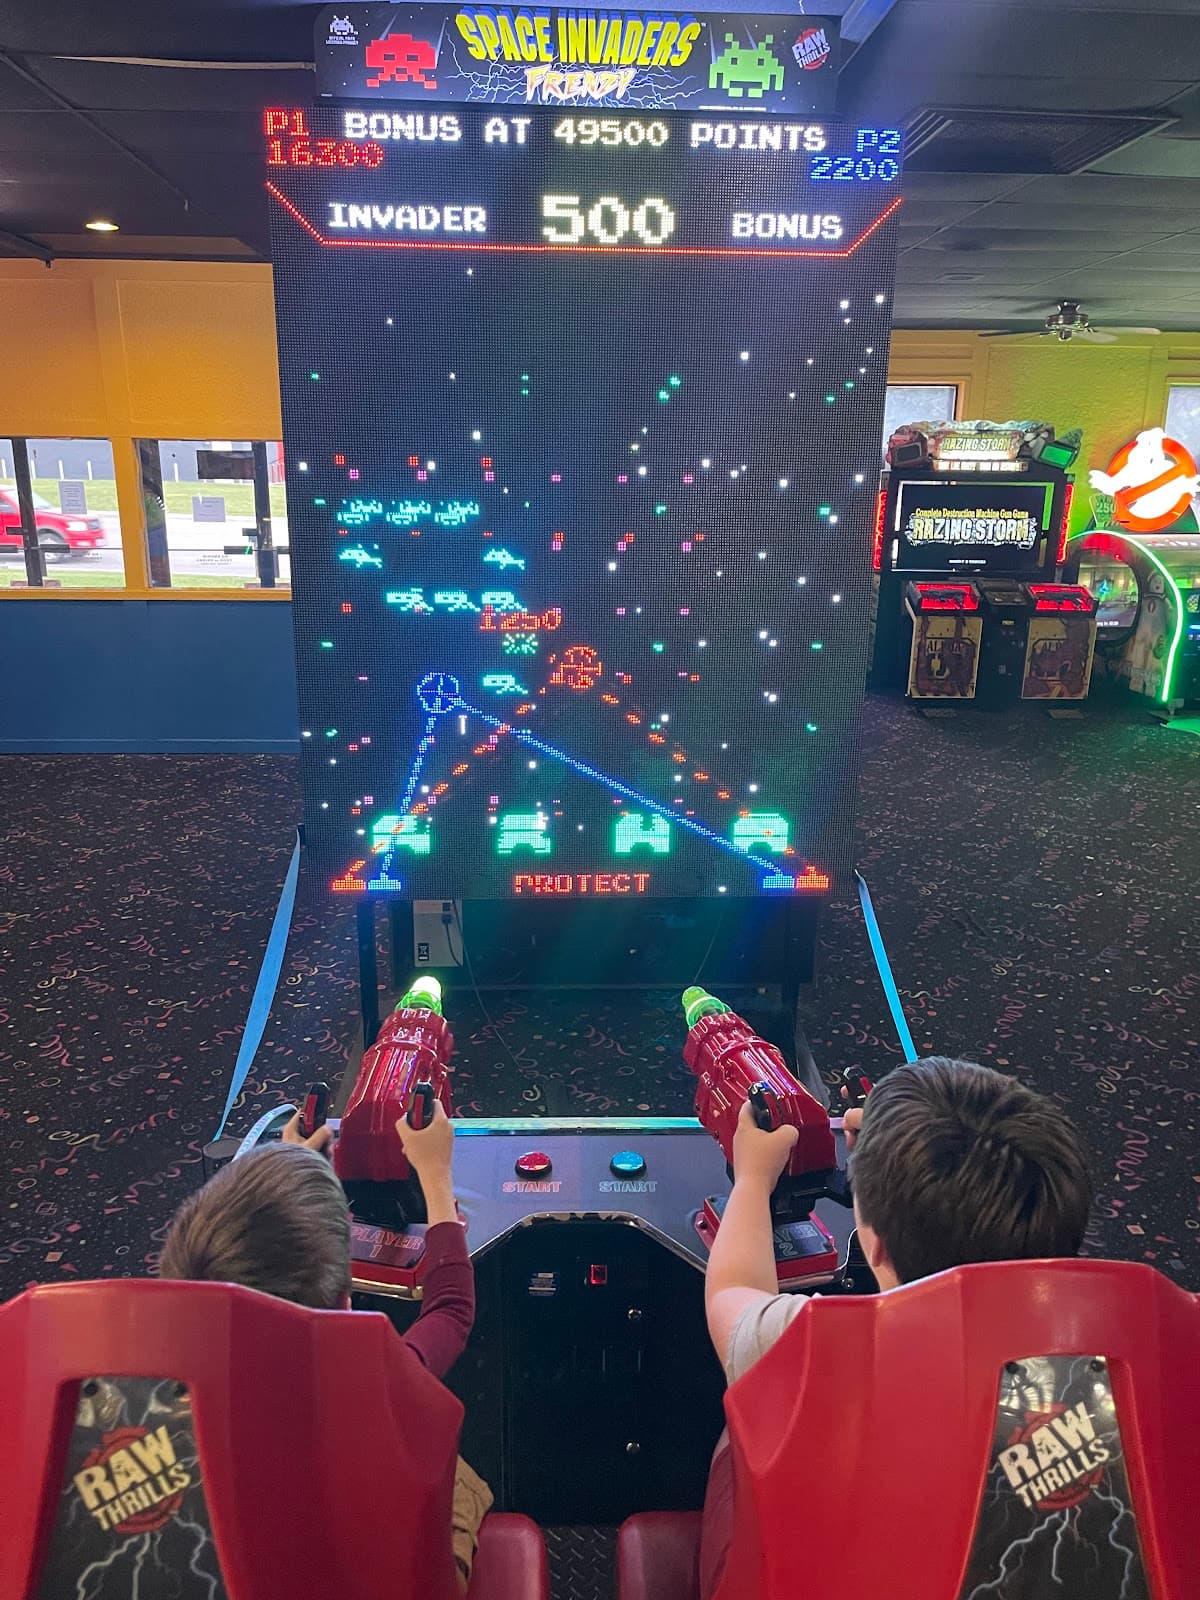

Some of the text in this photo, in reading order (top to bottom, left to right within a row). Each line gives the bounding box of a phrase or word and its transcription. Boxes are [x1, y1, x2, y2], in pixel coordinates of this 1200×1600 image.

[456, 9, 701, 66] SPACE INVADERS
[792, 28, 826, 60] RAW
[796, 42, 831, 68] THRILLS
[524, 64, 636, 100] FRENZY
[264, 111, 309, 136] P1
[344, 112, 827, 152] BONUS AT 49500 POINTS
[856, 129, 901, 153] P2
[266, 140, 385, 168] 16300
[811, 156, 899, 181] 2200
[328, 195, 843, 244] INVADER 500 BONUS
[943, 437, 1011, 451] RAZING STORM
[913, 518, 1029, 541] RAZING STORM
[480, 609, 562, 630] 1250
[514, 873, 650, 893] PROTECT
[502, 1181, 562, 1192] START
[599, 1181, 658, 1192] START
[369, 1244, 383, 1257] 1
[779, 1242, 799, 1256] 2
[999, 1401, 1095, 1488] RAW
[74, 1425, 176, 1512] RAW
[1015, 1438, 1110, 1508] THRILLS
[91, 1462, 191, 1531] THRILLS
